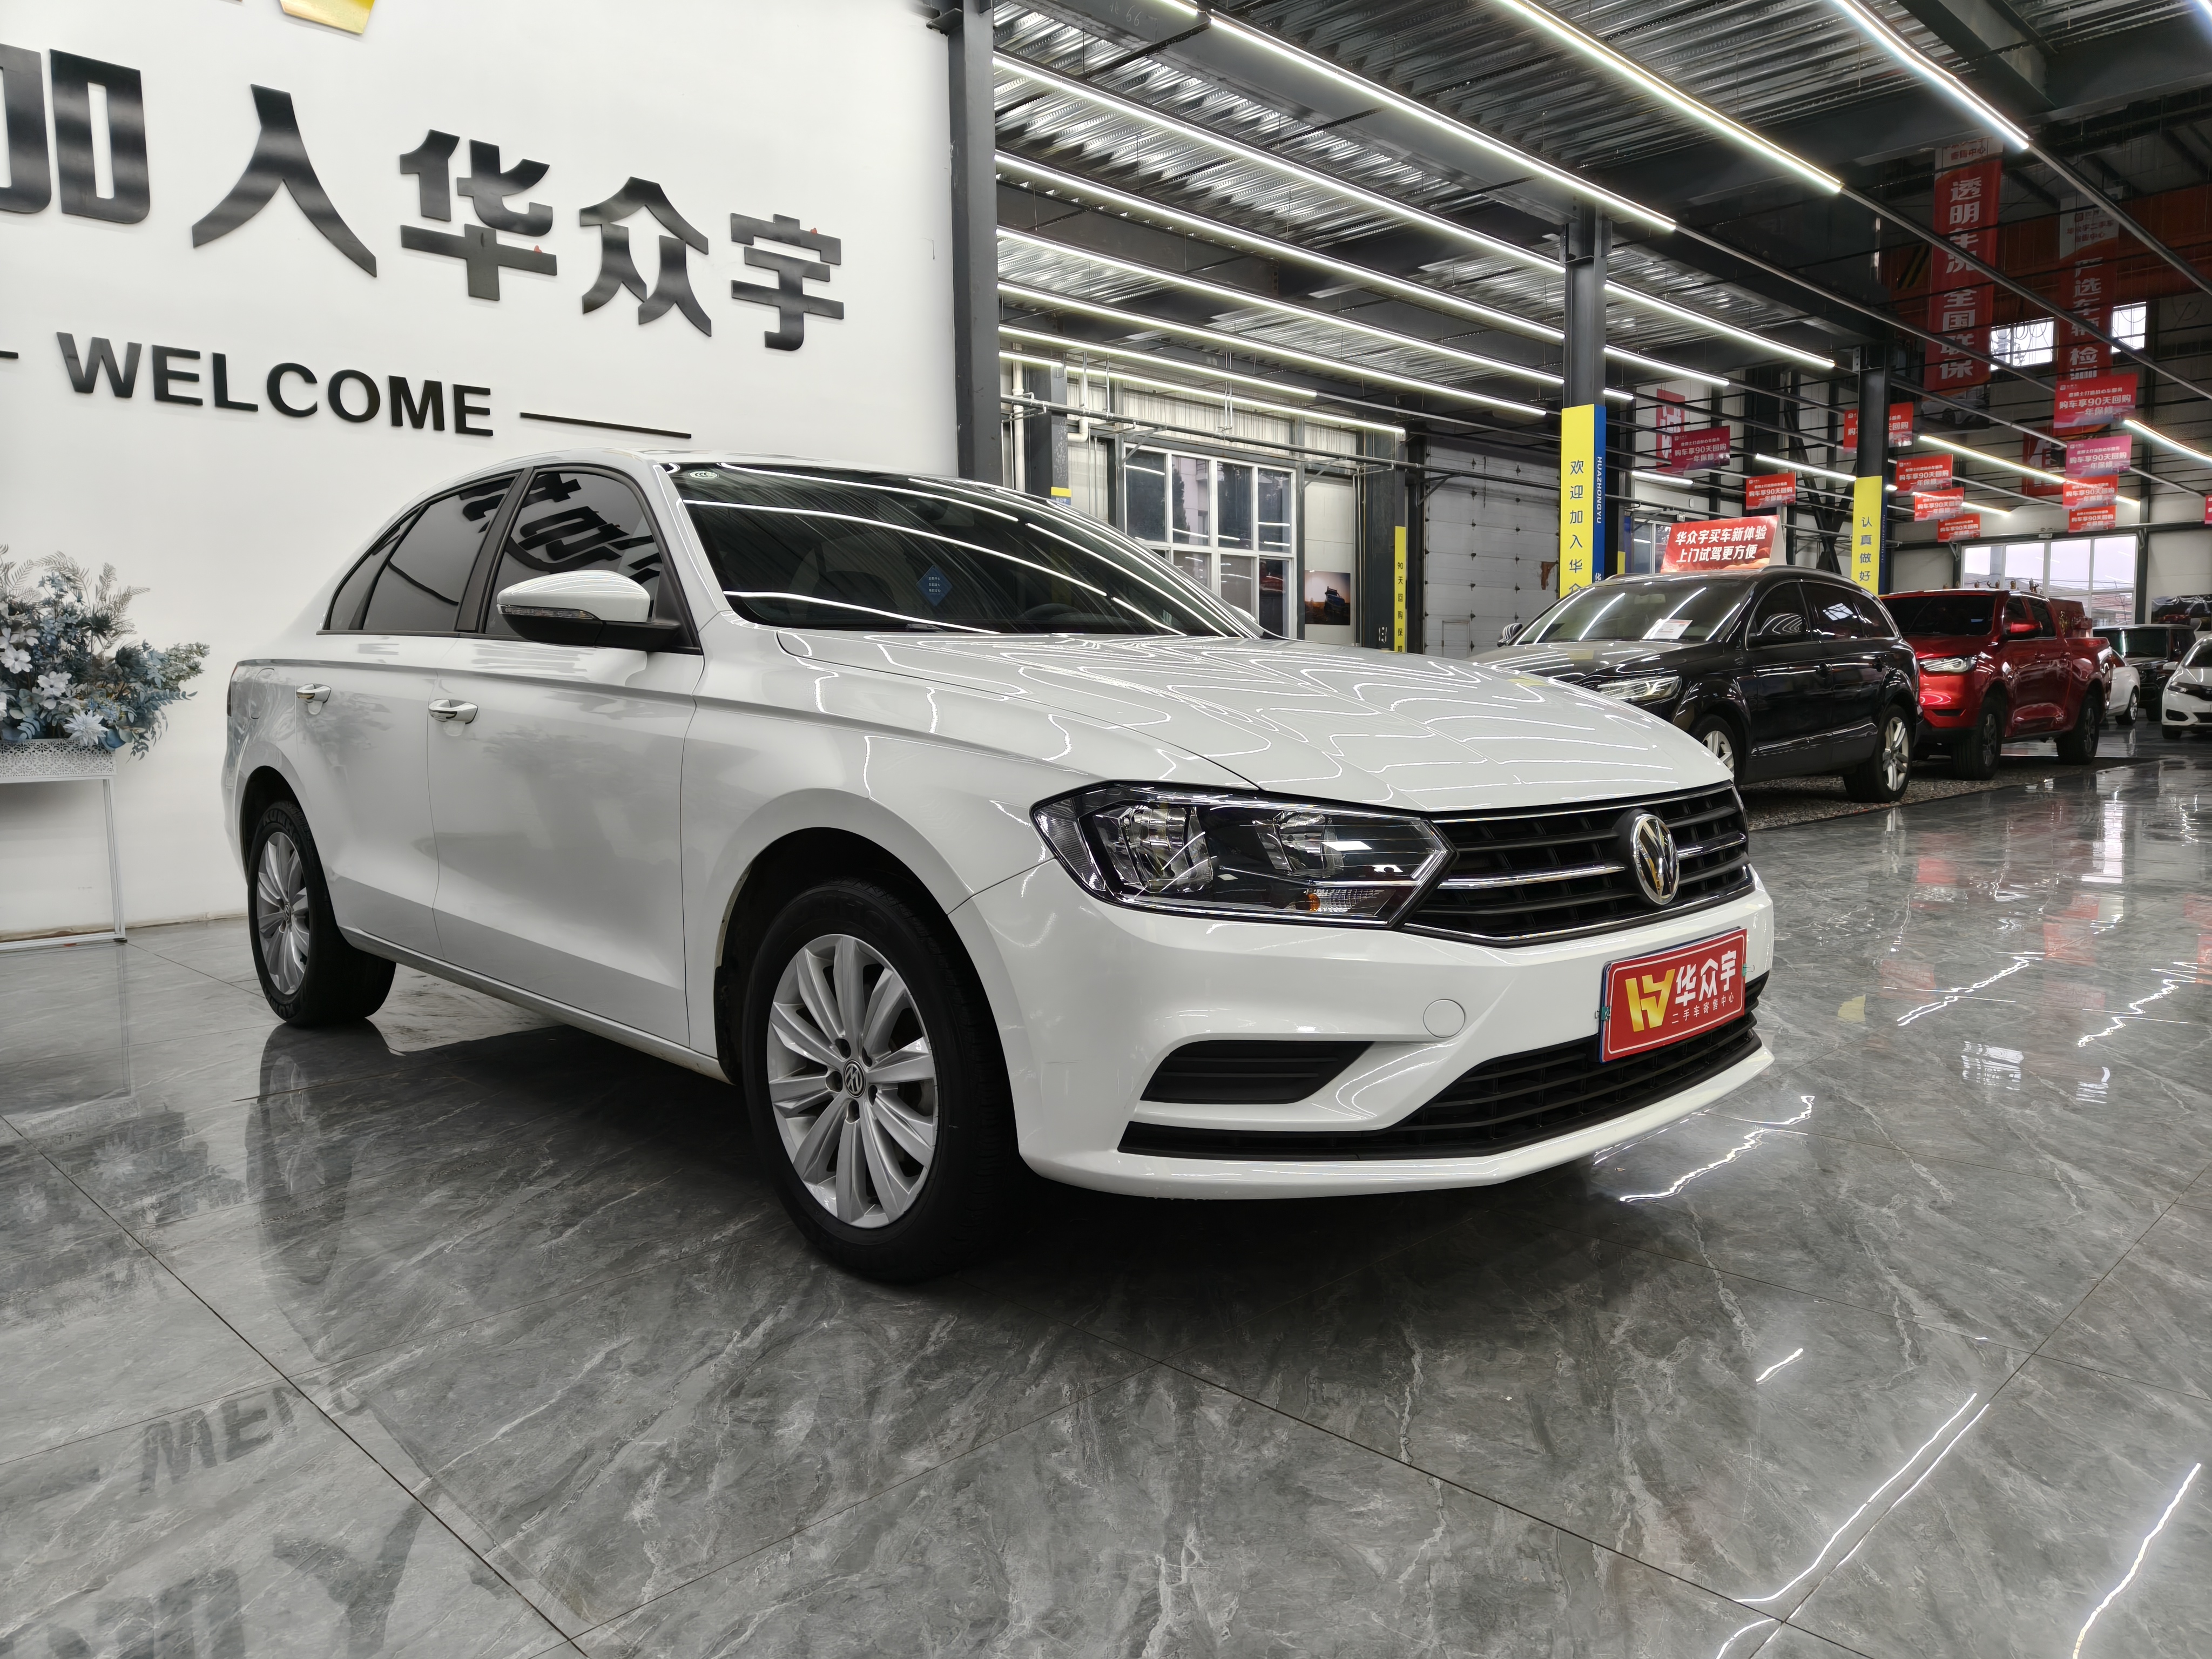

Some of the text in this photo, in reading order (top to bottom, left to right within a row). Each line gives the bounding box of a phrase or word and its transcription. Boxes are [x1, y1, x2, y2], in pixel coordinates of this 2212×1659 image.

[56, 332, 493, 436] WELCOME
[2059, 394, 2131, 409] 购车享90天回购
[1675, 443, 1727, 456] 购车享90天回购
[1675, 525, 1767, 545] 华众宇买车新体验
[1676, 544, 1758, 563] 上门试驾更方便
[1859, 516, 1872, 581] 认真做好
[1675, 950, 1736, 1007] 华众宇
[1671, 992, 1734, 1024] 二手车寄售中心
